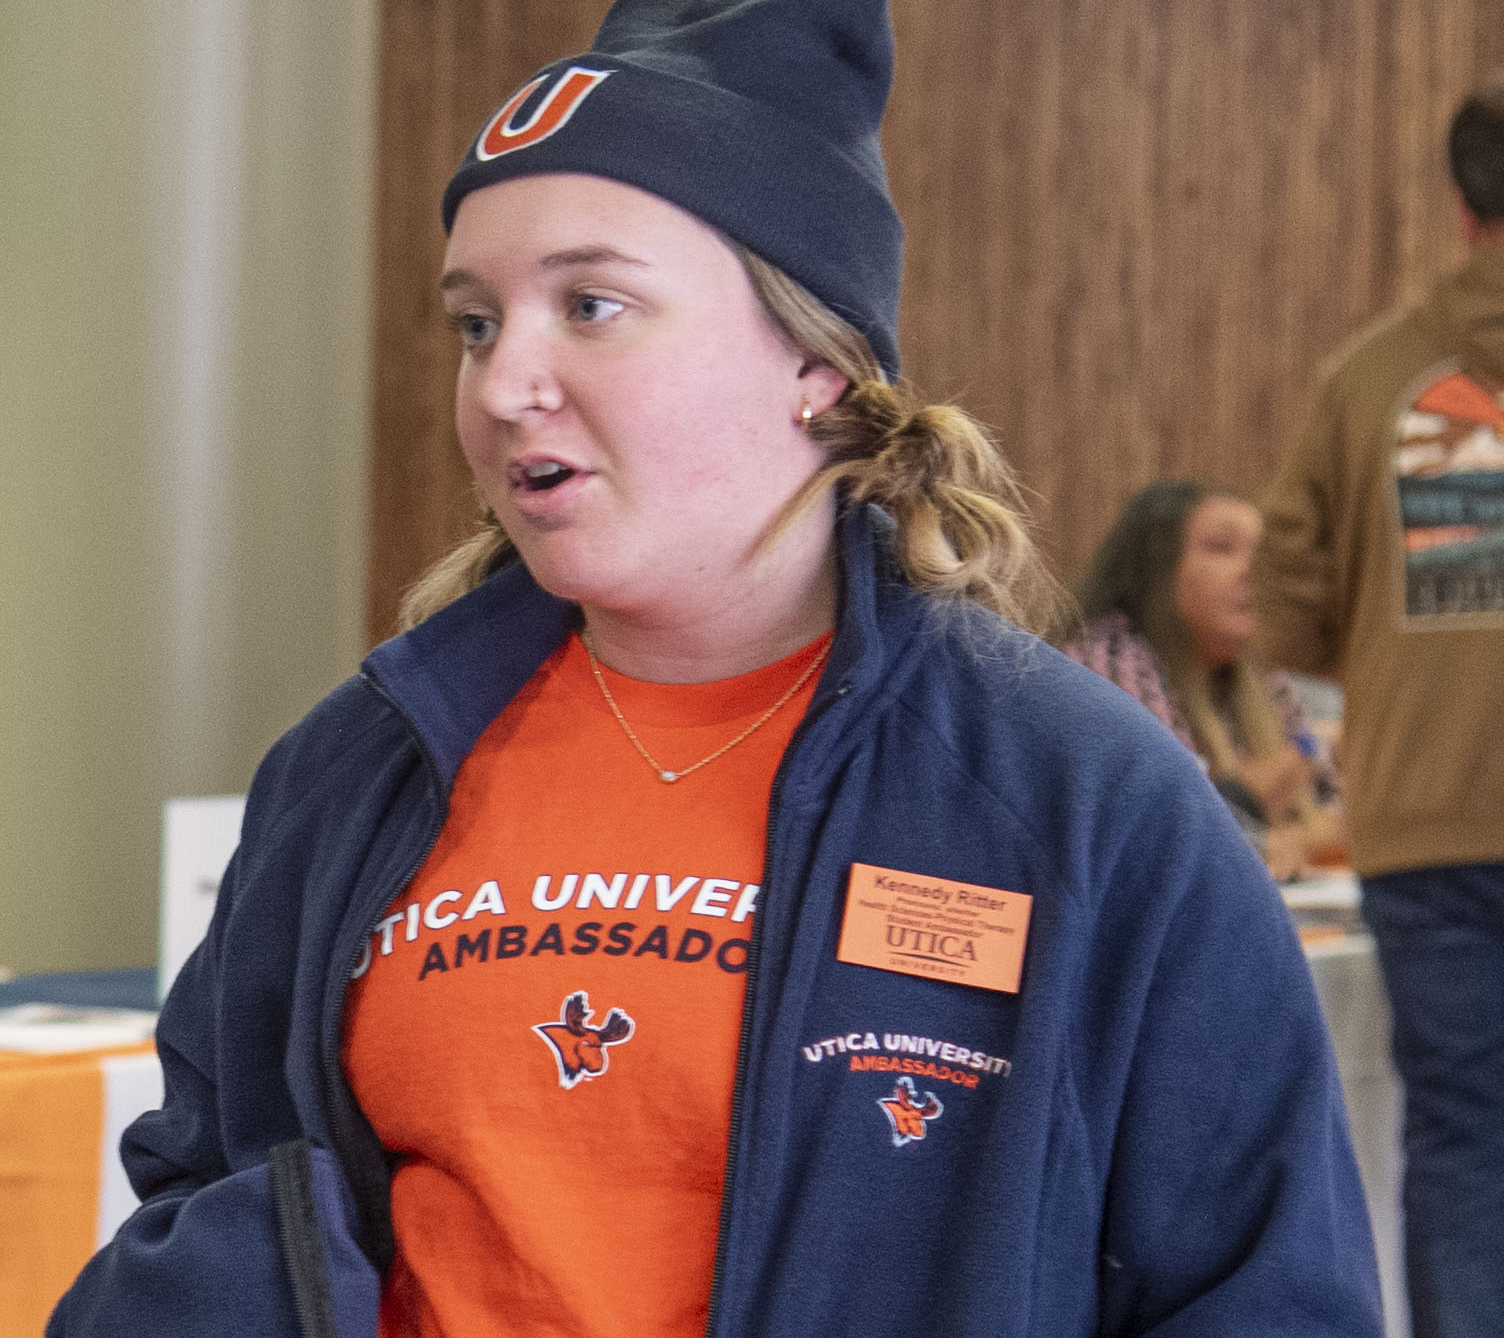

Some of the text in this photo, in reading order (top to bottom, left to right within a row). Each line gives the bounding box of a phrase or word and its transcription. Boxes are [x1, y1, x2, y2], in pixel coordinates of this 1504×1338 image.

[476, 66, 619, 162] U
[874, 875, 954, 904] Kennedy
[886, 924, 979, 962] UTICA
[803, 1032, 880, 1063] UTICA
[848, 1055, 981, 1090] AMBASSADOR
